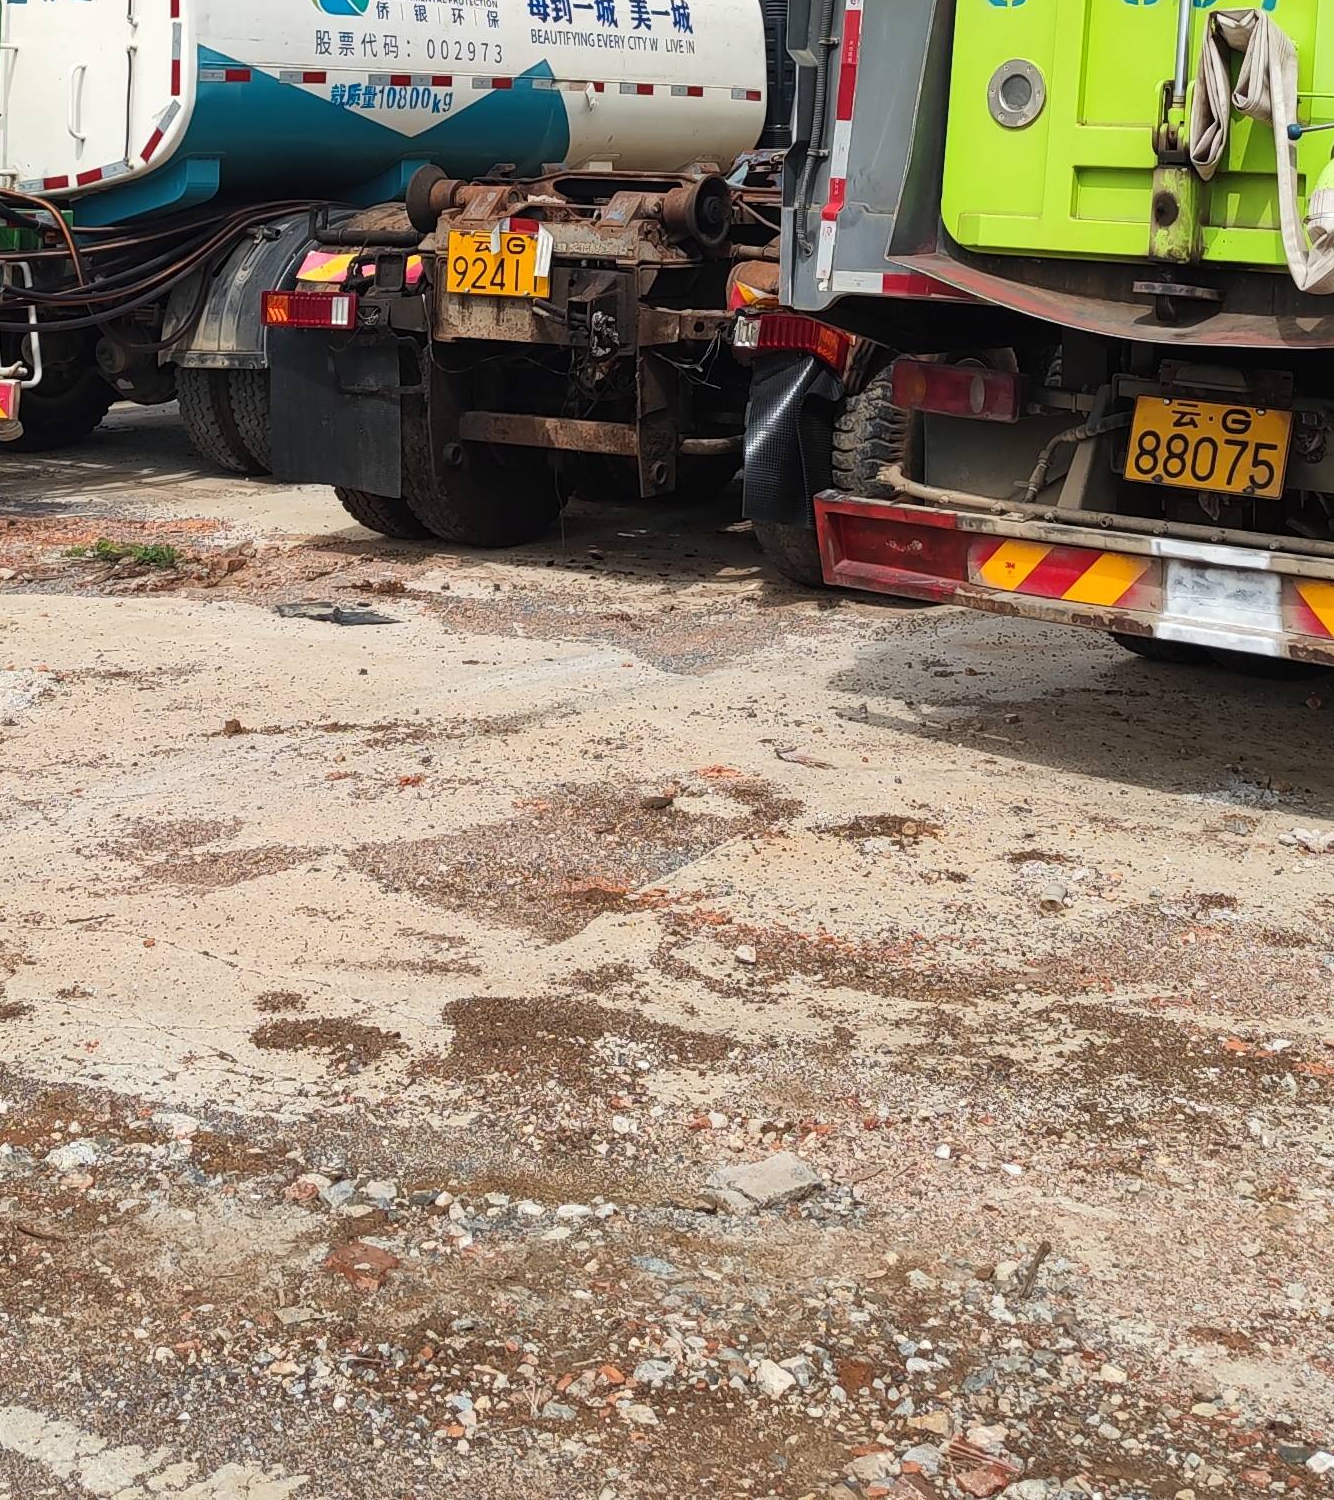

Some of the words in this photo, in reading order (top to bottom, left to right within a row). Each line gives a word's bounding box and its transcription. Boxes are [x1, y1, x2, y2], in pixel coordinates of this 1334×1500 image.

[426, 39, 502, 64] 002973
[531, 29, 595, 48] BEAUTIFYING
[597, 33, 625, 50] EVERY
[628, 36, 648, 51] CITY
[665, 39, 685, 53] LIVE
[685, 40, 695, 54] IN
[1134, 430, 1278, 490] 88075
